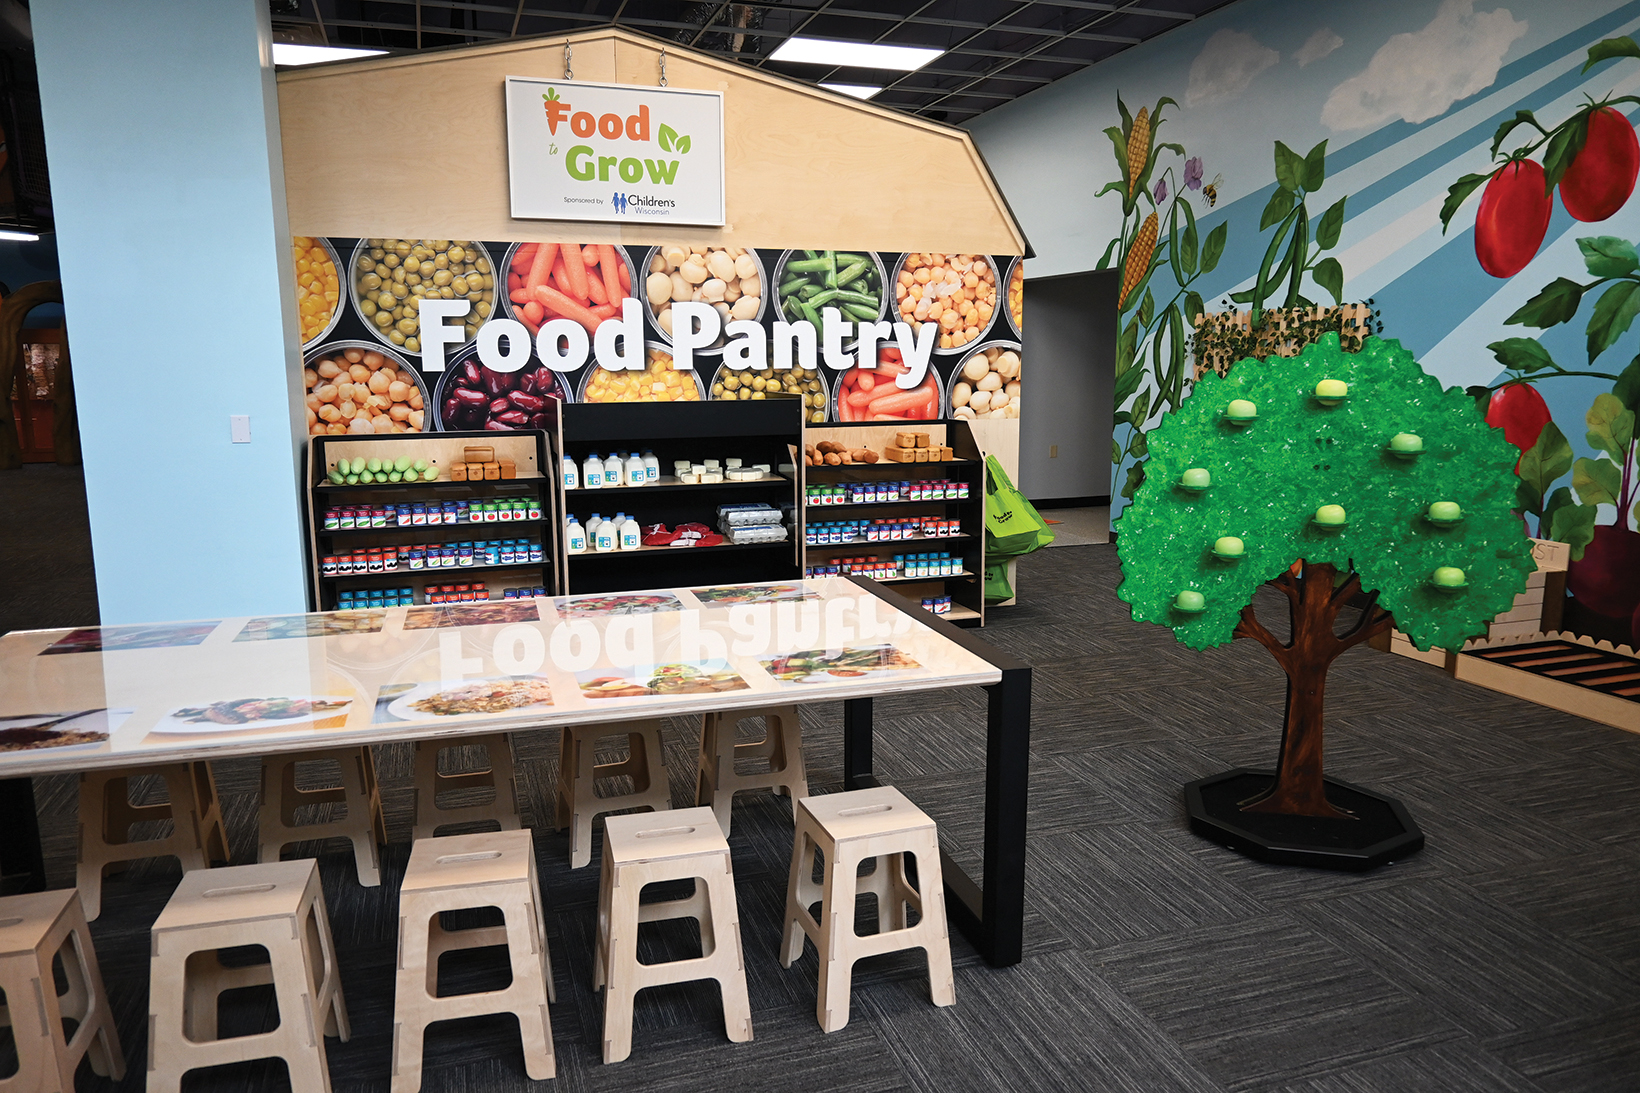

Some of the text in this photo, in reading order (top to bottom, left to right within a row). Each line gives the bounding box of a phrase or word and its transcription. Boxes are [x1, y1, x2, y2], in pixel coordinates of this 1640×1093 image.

[544, 100, 650, 141] Food
[549, 143, 558, 155] to
[566, 145, 680, 185] Grow
[563, 196, 604, 205] Sponsored by
[628, 194, 676, 208] Children's
[634, 206, 670, 216] Wisconsin
[418, 298, 938, 389] Food Pantry
[1531, 543, 1560, 562] ST
